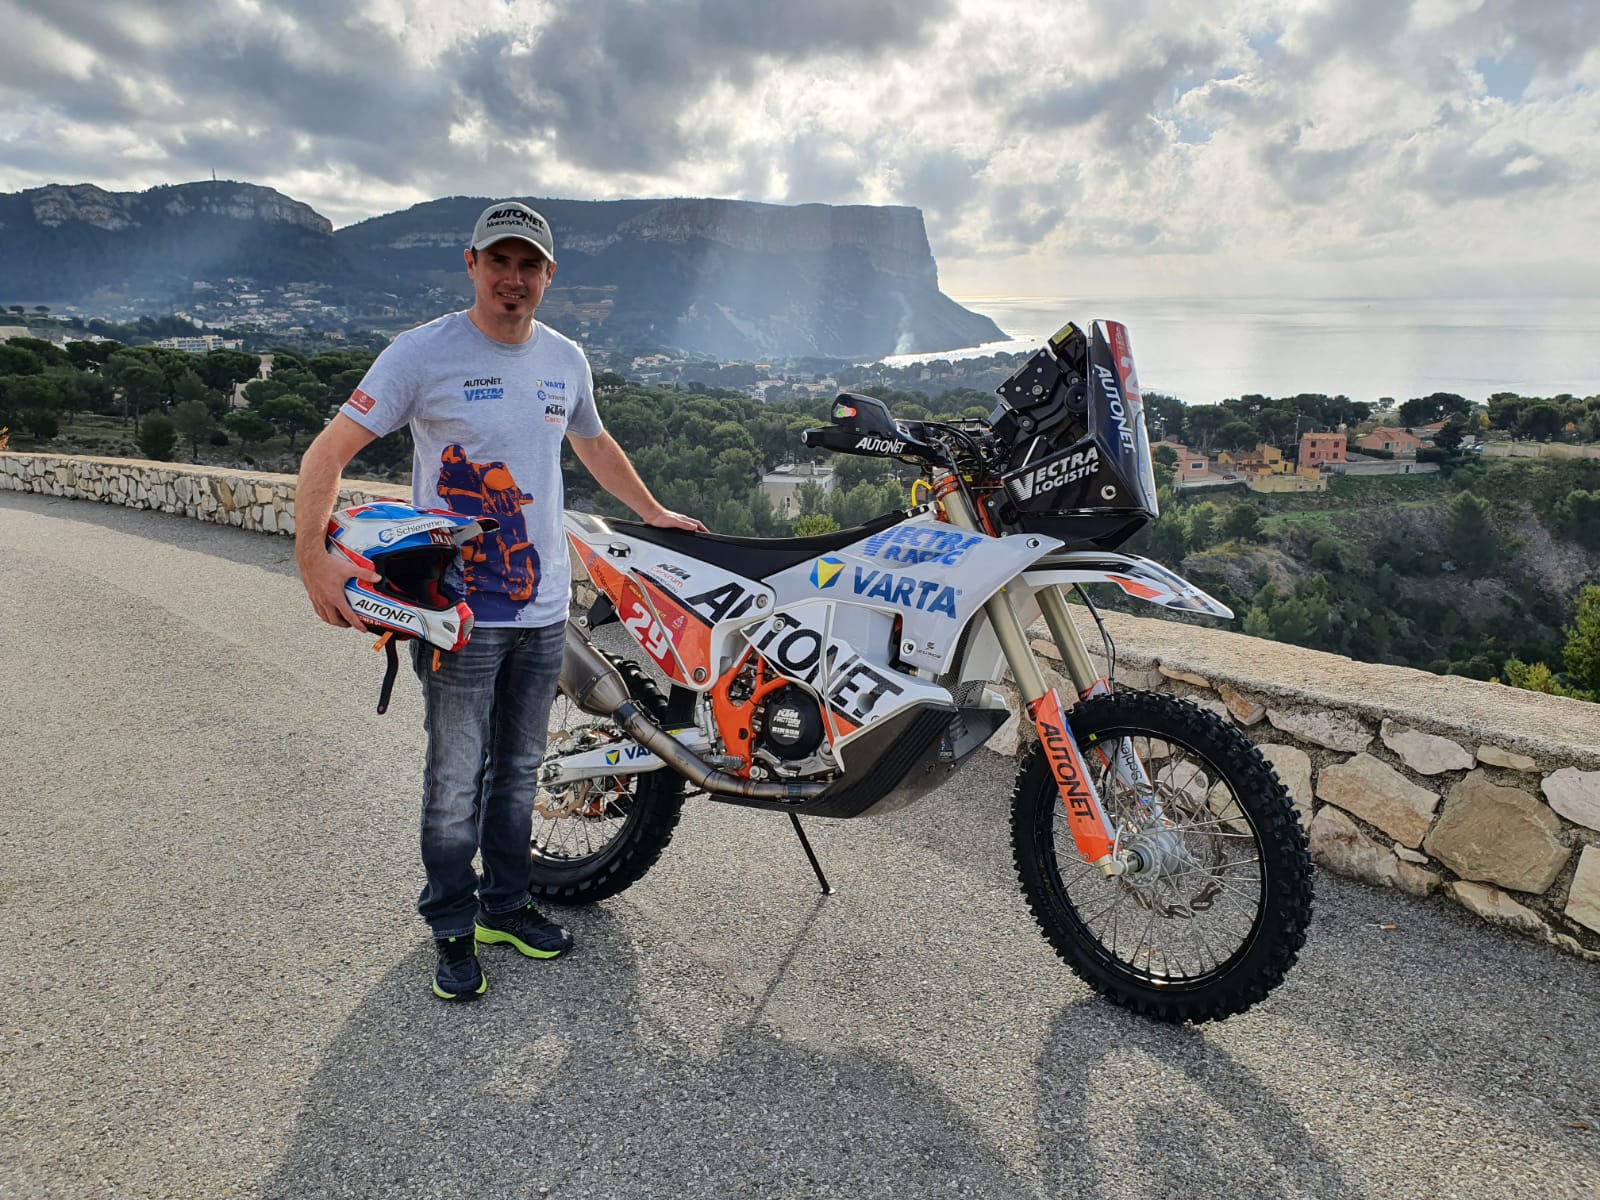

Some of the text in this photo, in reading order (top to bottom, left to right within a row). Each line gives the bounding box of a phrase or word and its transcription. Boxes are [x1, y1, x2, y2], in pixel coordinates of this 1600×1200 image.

[486, 220, 523, 229] Motorcycle
[855, 437, 907, 454] AUTONET
[1009, 447, 1099, 501] VECTRA
[1035, 462, 1100, 495] LOGISTIC
[395, 519, 446, 538] Schlemmer
[355, 599, 415, 624] AUTONET
[625, 602, 674, 660] 29
[1120, 741, 1143, 782] Schle
